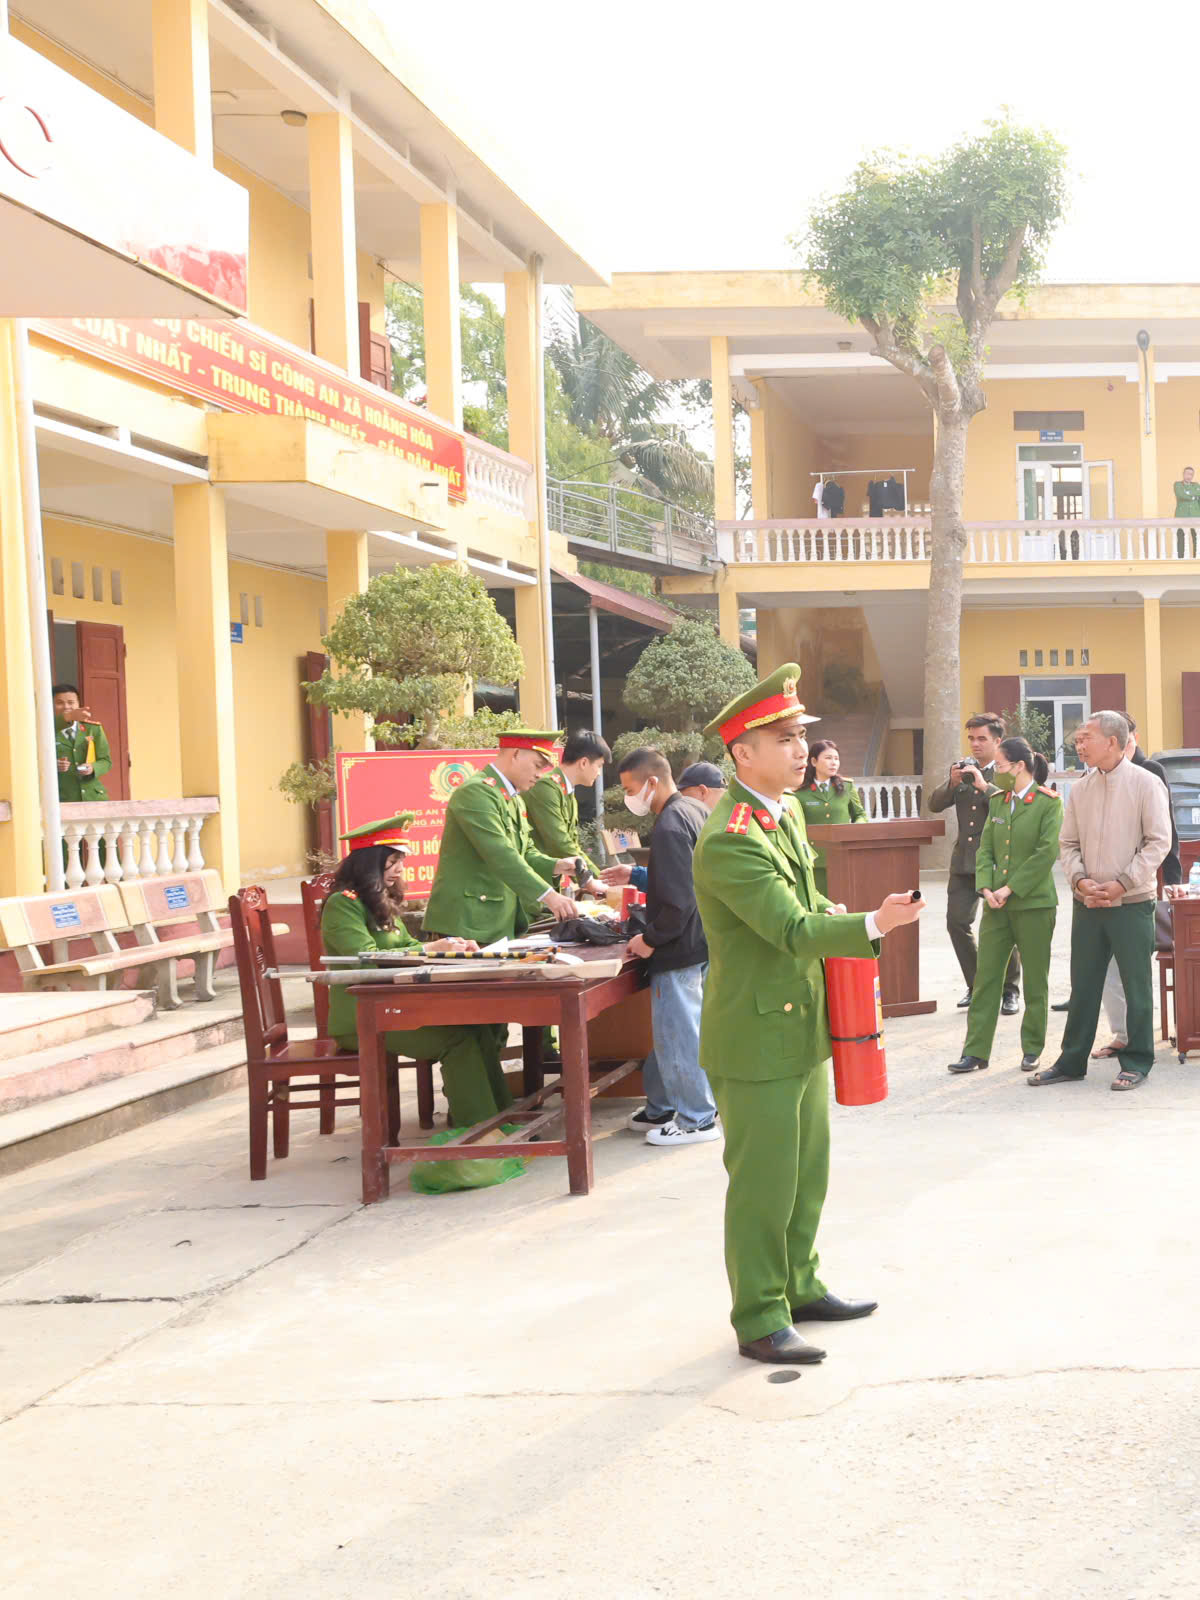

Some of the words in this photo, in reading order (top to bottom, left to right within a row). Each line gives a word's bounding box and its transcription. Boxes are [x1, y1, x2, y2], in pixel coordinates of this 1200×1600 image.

[136, 332, 192, 374] NHẤT
[210, 364, 270, 408] TRUNG
[186, 319, 244, 364] CHIẾN
[249, 350, 267, 375] SĨ
[271, 360, 315, 397] CÔNG
[319, 384, 340, 408] AN
[343, 395, 362, 419] XÃ
[410, 426, 434, 451] HÓA
[418, 865, 435, 884] CỤ
